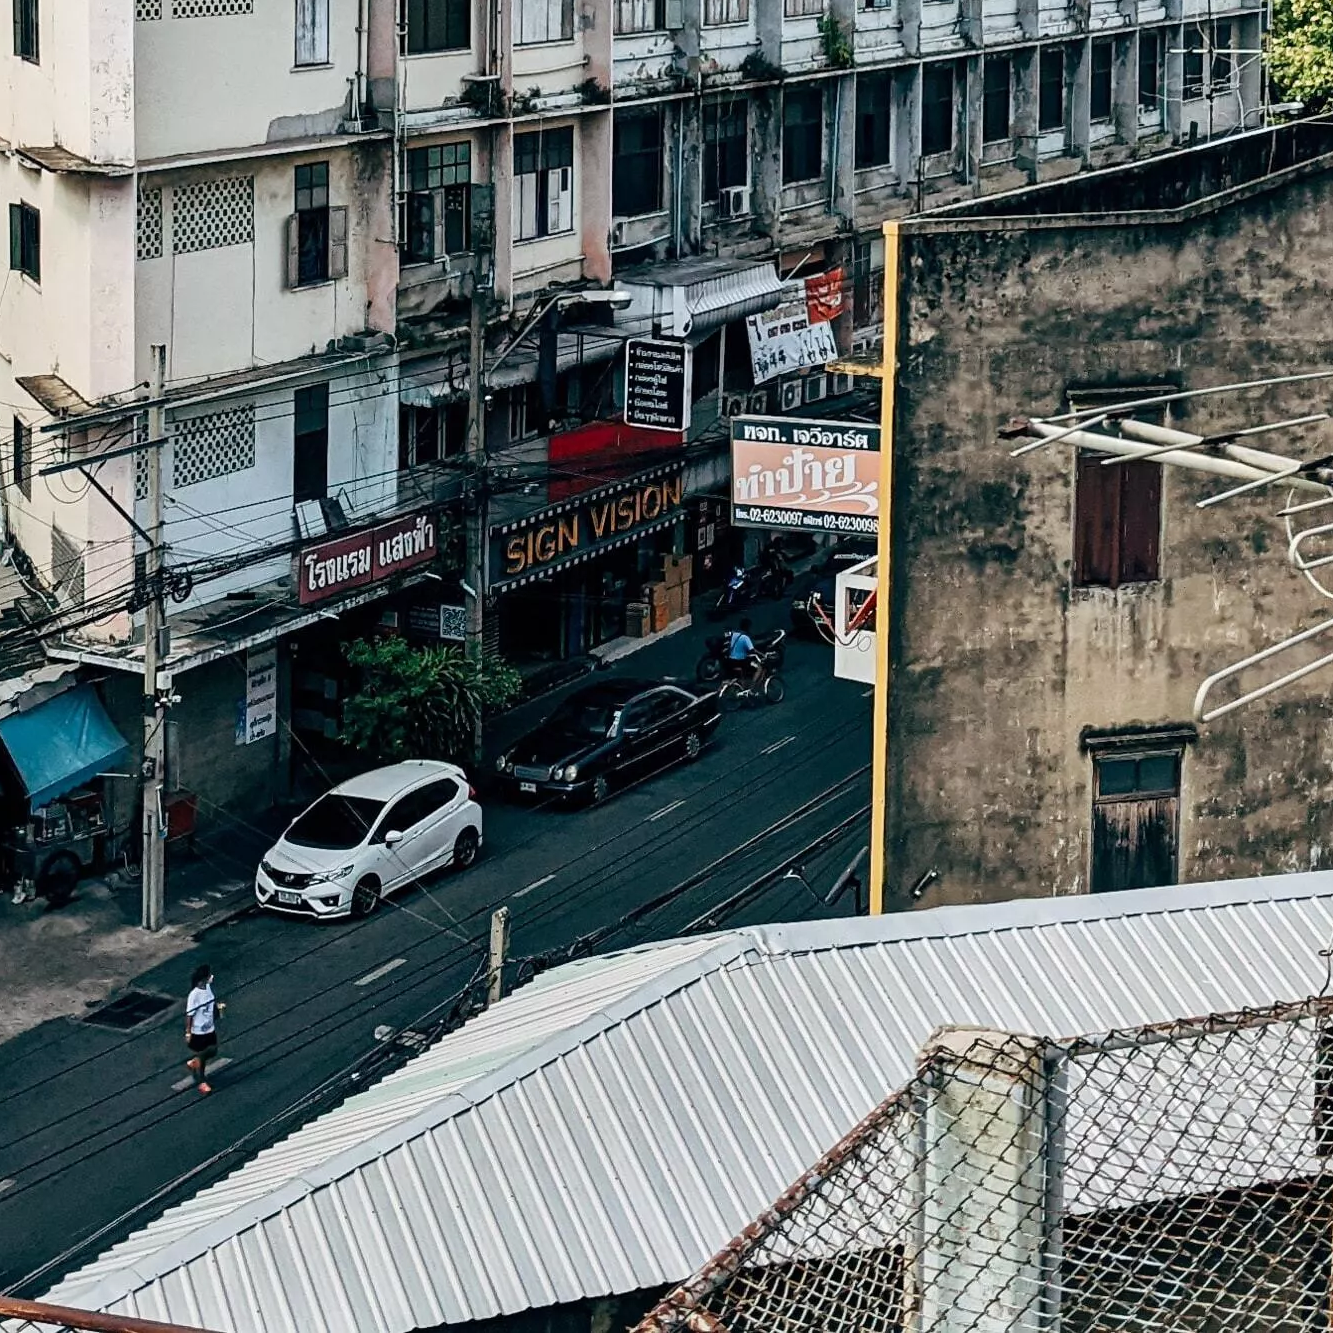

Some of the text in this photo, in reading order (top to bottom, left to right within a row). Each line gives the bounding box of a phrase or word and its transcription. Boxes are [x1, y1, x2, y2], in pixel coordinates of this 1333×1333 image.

[743, 425, 869, 449] หจก. เจวีอาร์ต
[736, 447, 856, 500] ทำป้าย
[506, 476, 682, 574] SIGN VISION
[750, 507, 803, 526] 02-6230097
[304, 515, 434, 591] โรงแรม แสงฟ้า
